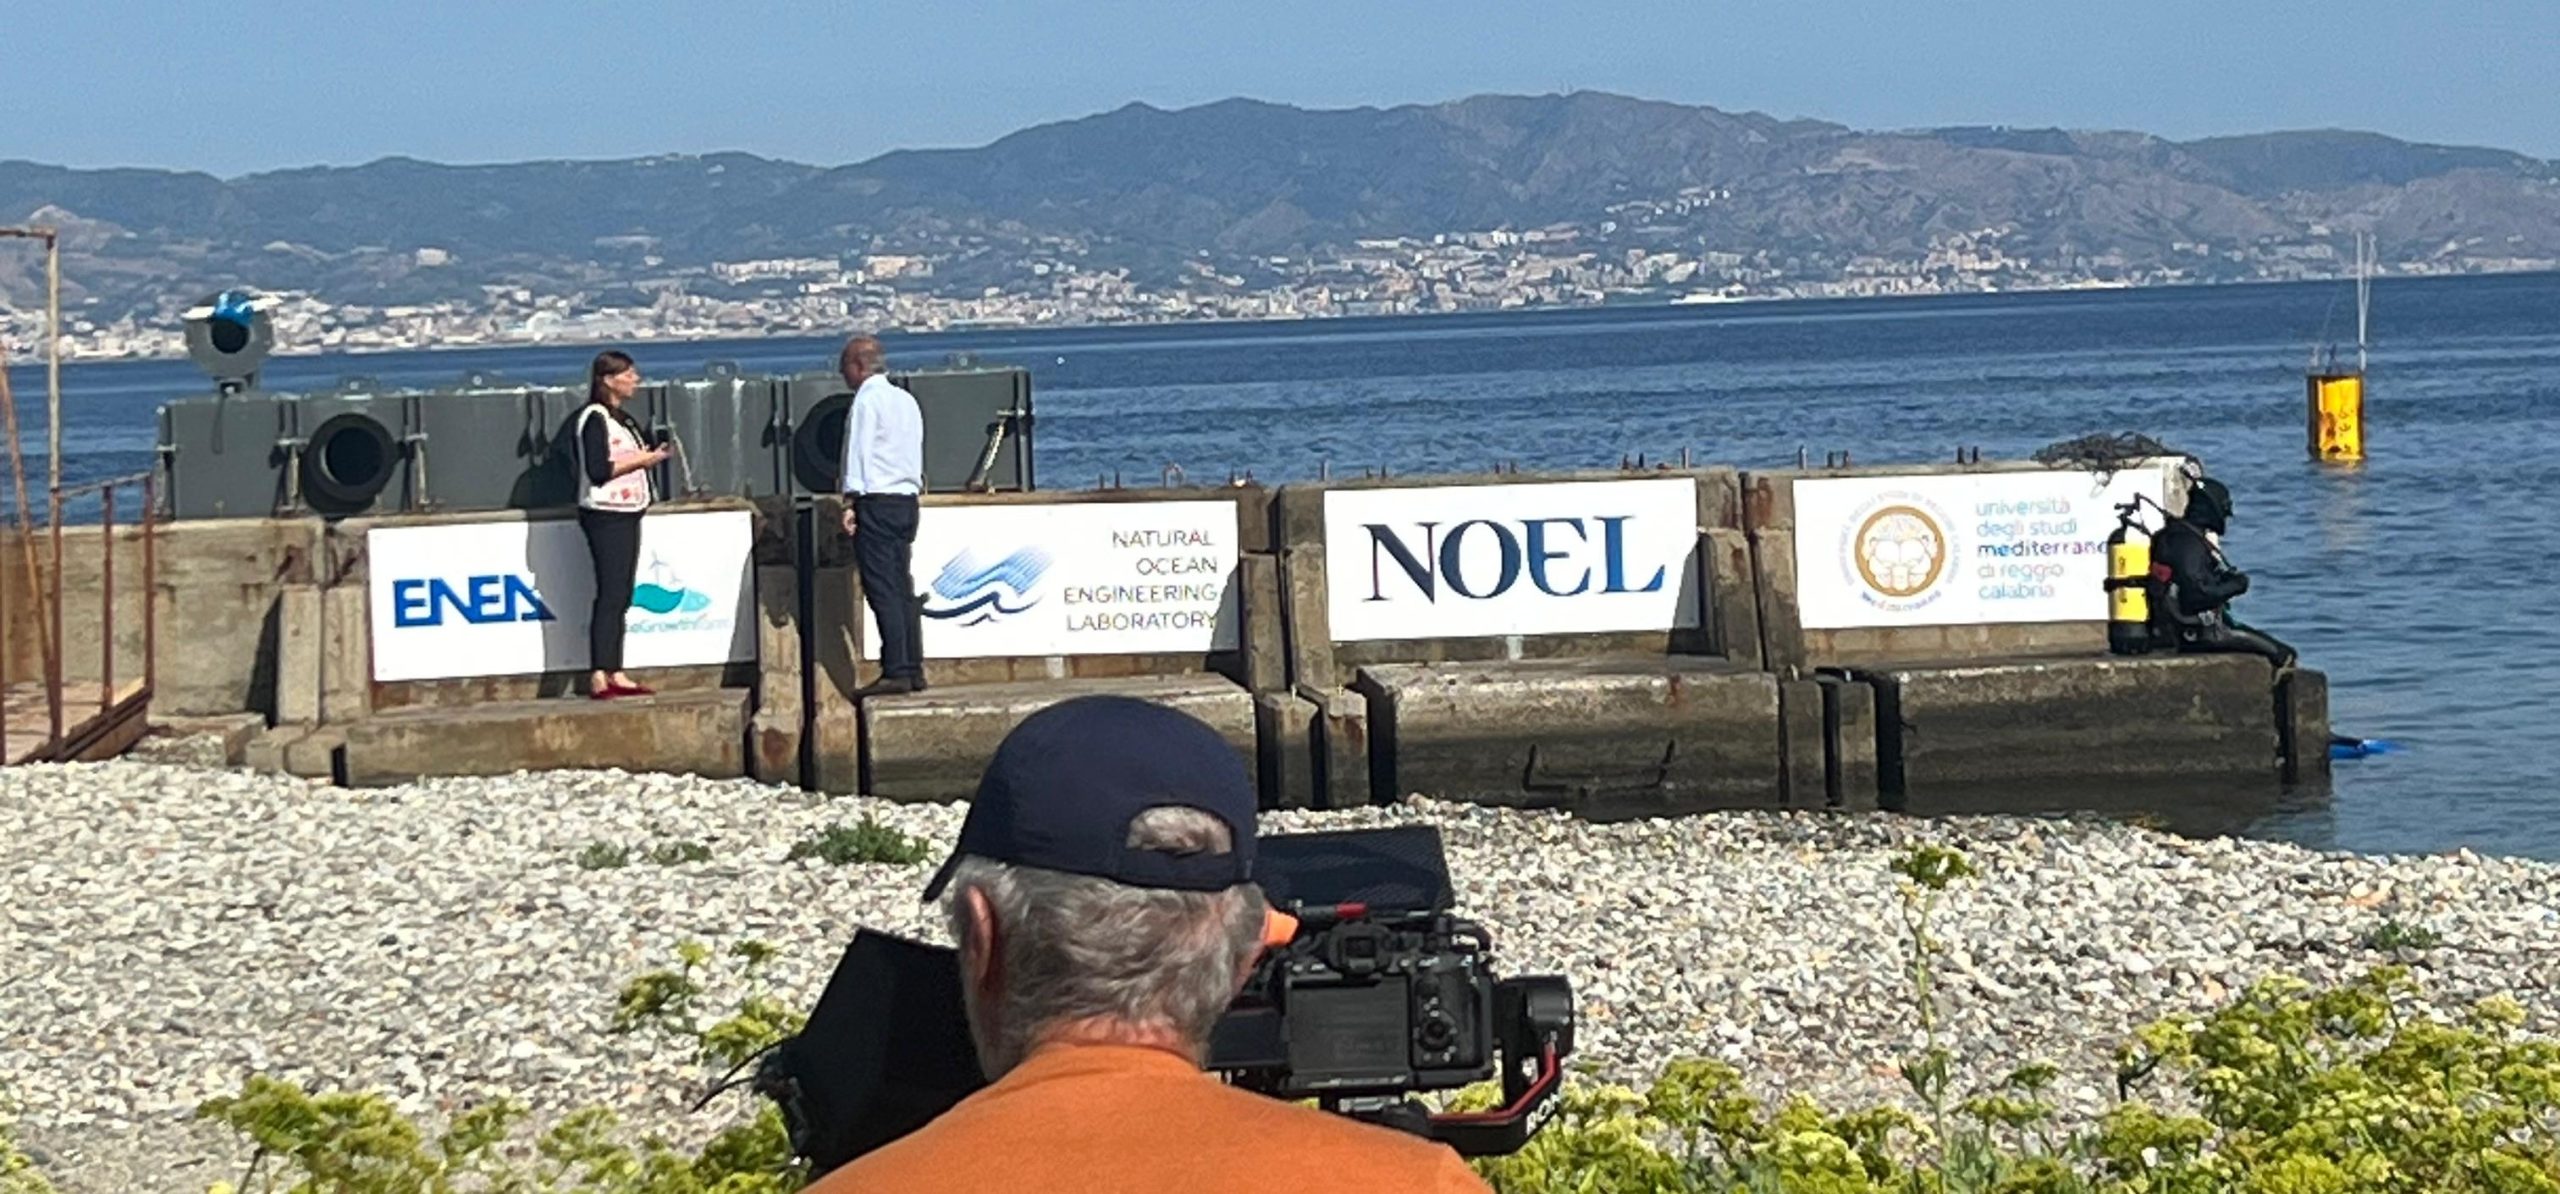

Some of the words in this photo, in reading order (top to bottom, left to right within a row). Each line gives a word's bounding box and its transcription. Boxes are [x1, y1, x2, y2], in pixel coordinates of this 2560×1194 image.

[1975, 497, 2071, 517] università
[1111, 528, 1215, 549] NATURAL
[1976, 519, 2025, 541] degli
[2028, 518, 2078, 536] studi
[1976, 540, 2108, 558] mediterrane
[1136, 556, 1218, 576] OCEAN
[1359, 515, 1665, 605] NOEL
[1977, 562, 1996, 579] di
[2000, 562, 2064, 583] reggio
[392, 574, 557, 628] ENEA
[1063, 583, 1218, 605] ENGINEERING
[1978, 581, 2055, 600] calabria
[1066, 610, 1217, 632] LABORATORY
